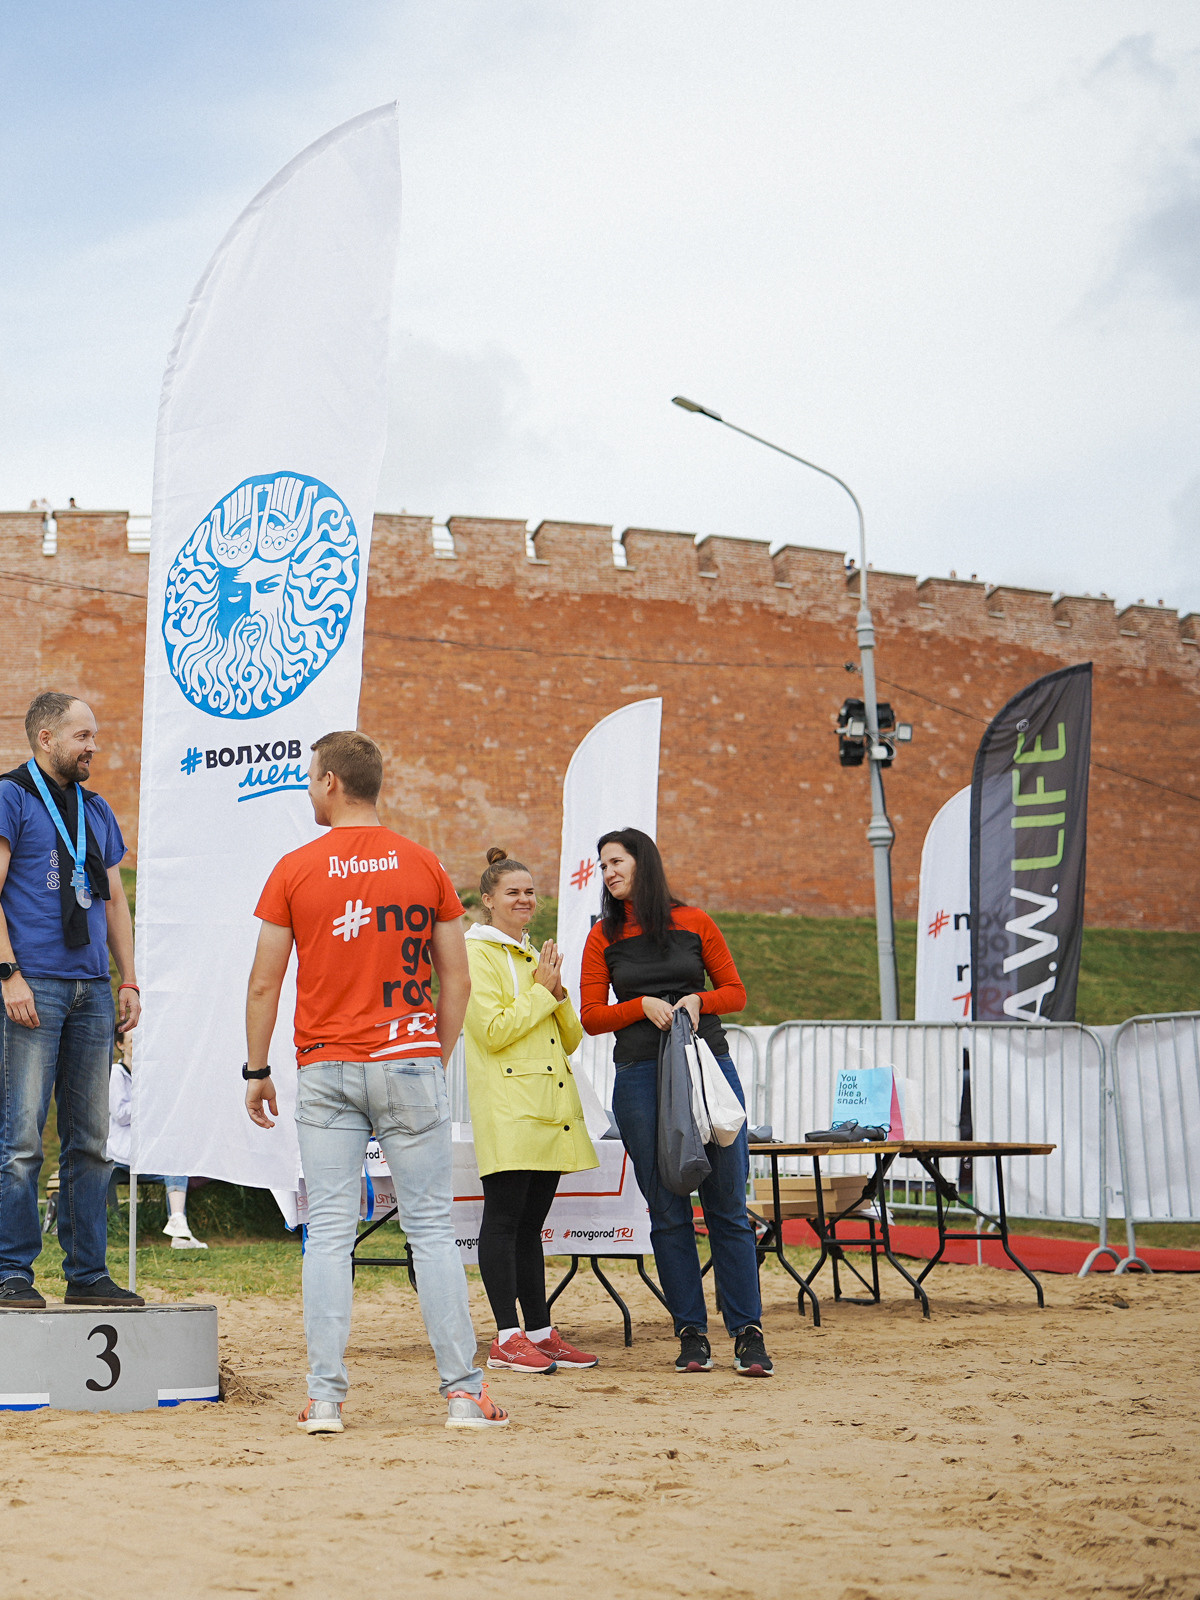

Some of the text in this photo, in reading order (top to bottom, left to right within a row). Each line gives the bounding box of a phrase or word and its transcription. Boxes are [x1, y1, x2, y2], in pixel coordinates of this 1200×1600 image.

[181, 739, 302, 775] #ВОЛХОВ
[328, 850, 399, 879] Дубовой
[841, 1074, 857, 1082] You
[839, 1081, 858, 1090] look
[838, 1090, 855, 1098] like
[837, 1097, 868, 1106] snack!
[86, 1324, 121, 1392] 3
